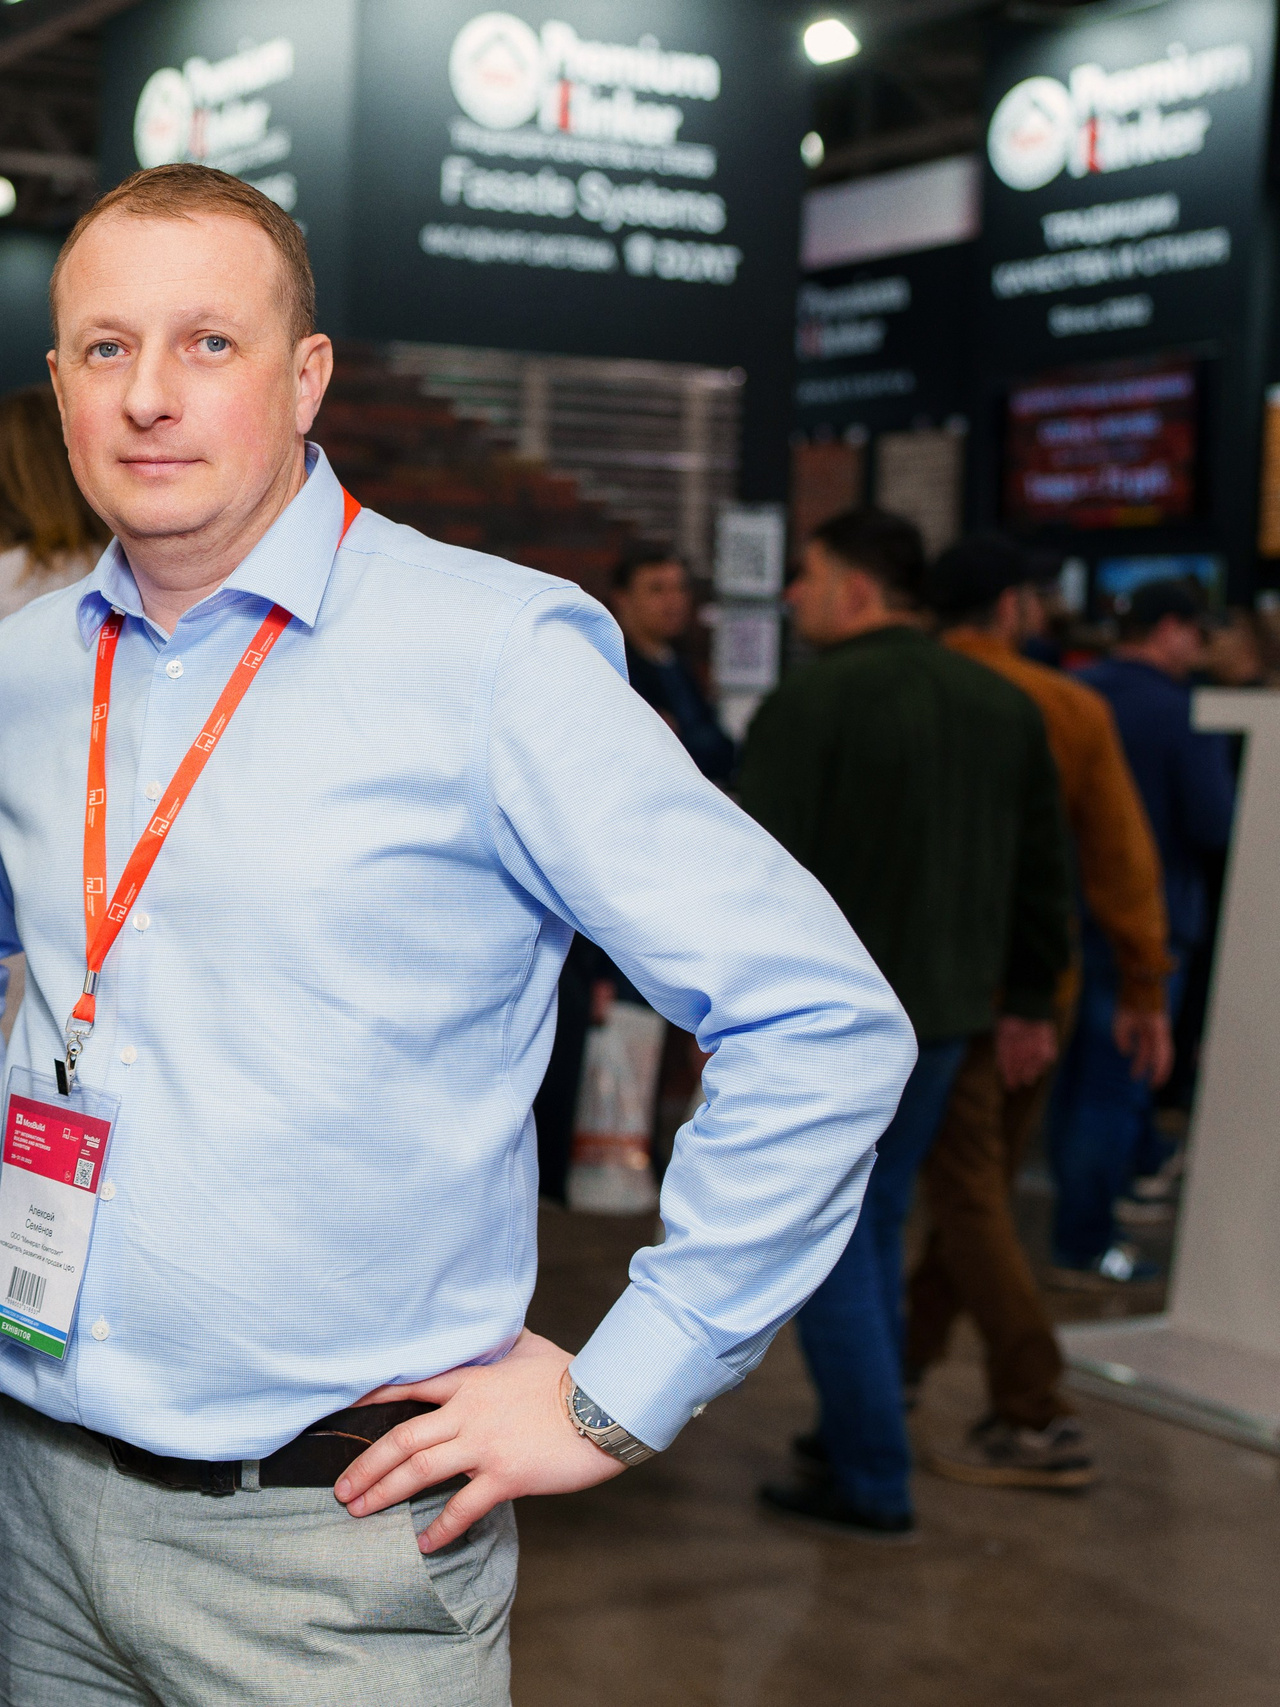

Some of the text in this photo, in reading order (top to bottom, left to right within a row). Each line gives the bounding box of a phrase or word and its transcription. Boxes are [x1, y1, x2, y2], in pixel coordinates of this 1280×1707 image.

[576, 170, 726, 234] Systems
[23, 1119, 46, 1132] MosBuild
[28, 1204, 55, 1221] Алексей
[10, 1231, 20, 1241] ООО
[25, 1218, 53, 1237] Семёнов
[63, 1263, 75, 1273] ЦФО
[1, 1321, 31, 1341] EXHIBITOR
